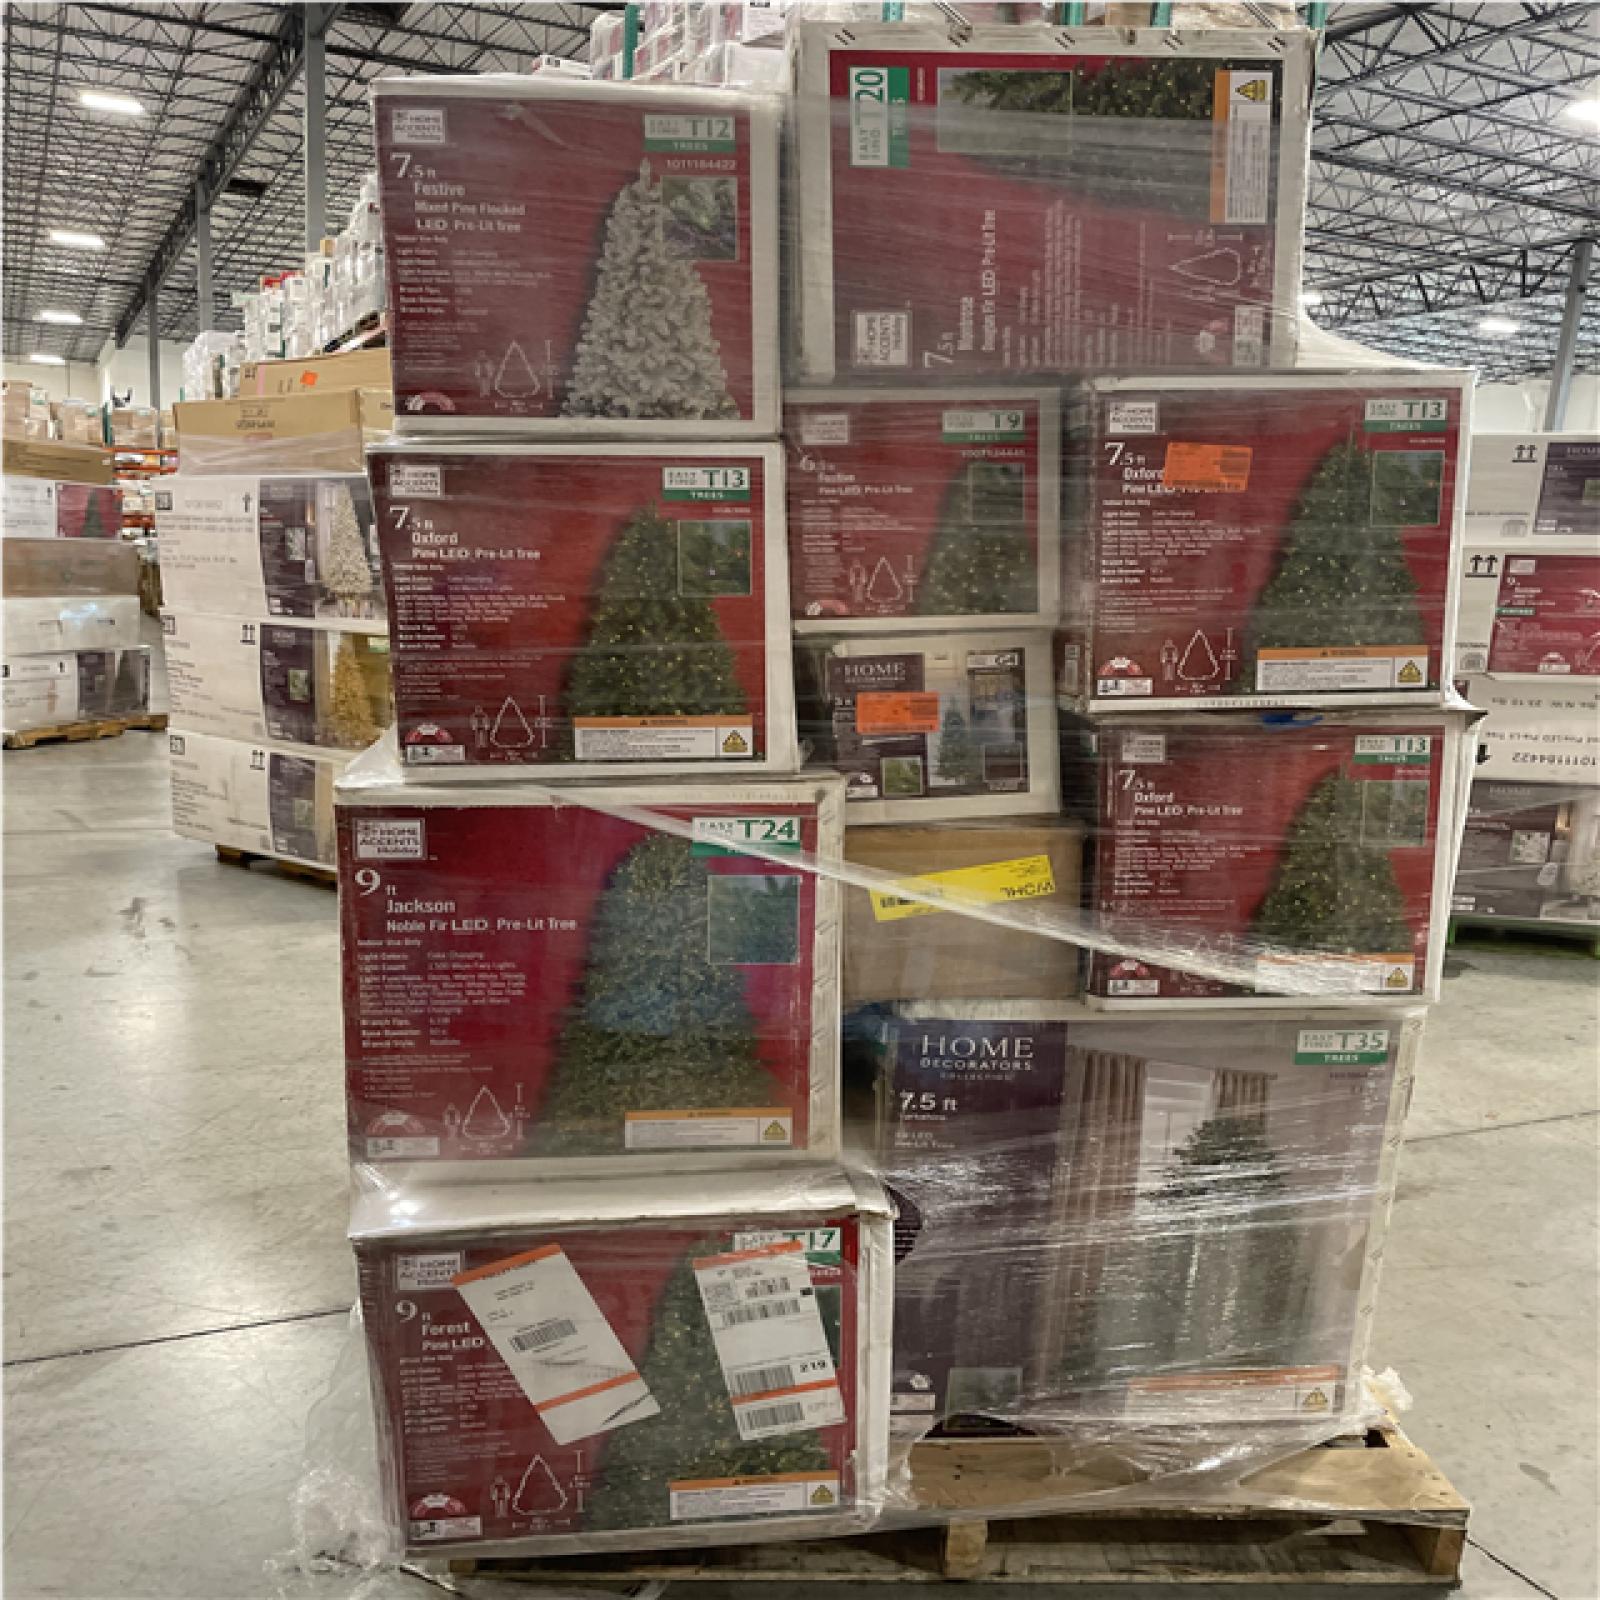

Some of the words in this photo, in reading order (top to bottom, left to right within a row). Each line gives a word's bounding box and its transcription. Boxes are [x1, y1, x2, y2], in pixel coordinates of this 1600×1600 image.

[686, 119, 730, 138] T12
[1401, 401, 1442, 419] T13
[702, 468, 744, 488] T13
[411, 531, 459, 546] Oxford
[516, 548, 541, 561] Tree
[844, 661, 906, 677] HOME
[1134, 791, 1174, 804] Oxford
[736, 818, 795, 841] T24
[359, 837, 420, 848] ACCENTS
[354, 867, 381, 897] 9
[386, 898, 456, 914] Jackson
[386, 919, 426, 933] Noble
[429, 918, 449, 931] Fir
[451, 918, 489, 934] LED
[496, 917, 546, 931] Pre-Lit
[548, 917, 578, 931] Tree
[920, 1033, 1034, 1059] HOME
[1335, 1031, 1387, 1051] T35
[919, 1057, 1033, 1071] DECORATORS
[900, 1091, 935, 1111] 7.5
[395, 1299, 418, 1322] 9
[421, 1321, 471, 1336] Forest
[452, 1335, 485, 1350] LED
